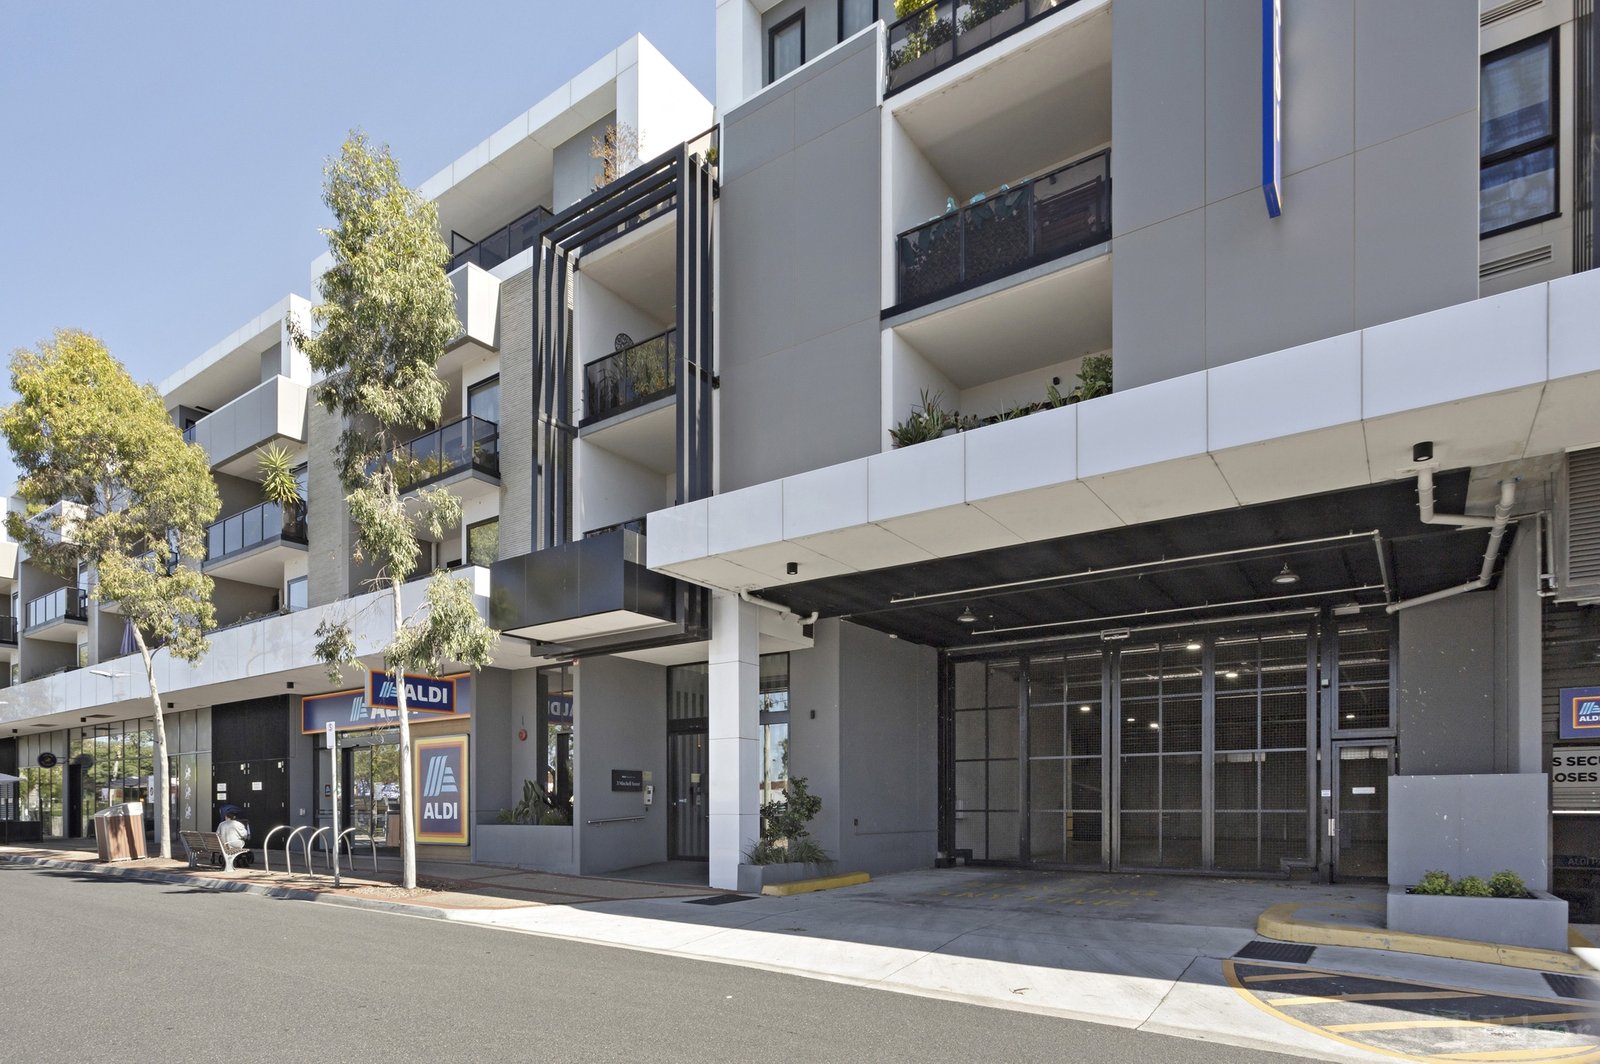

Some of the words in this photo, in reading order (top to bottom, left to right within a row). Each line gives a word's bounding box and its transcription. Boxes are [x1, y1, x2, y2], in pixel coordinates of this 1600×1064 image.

[404, 683, 448, 704] ALDI
[1552, 772, 1598, 783] OSES
[423, 802, 458, 820] ALDI
